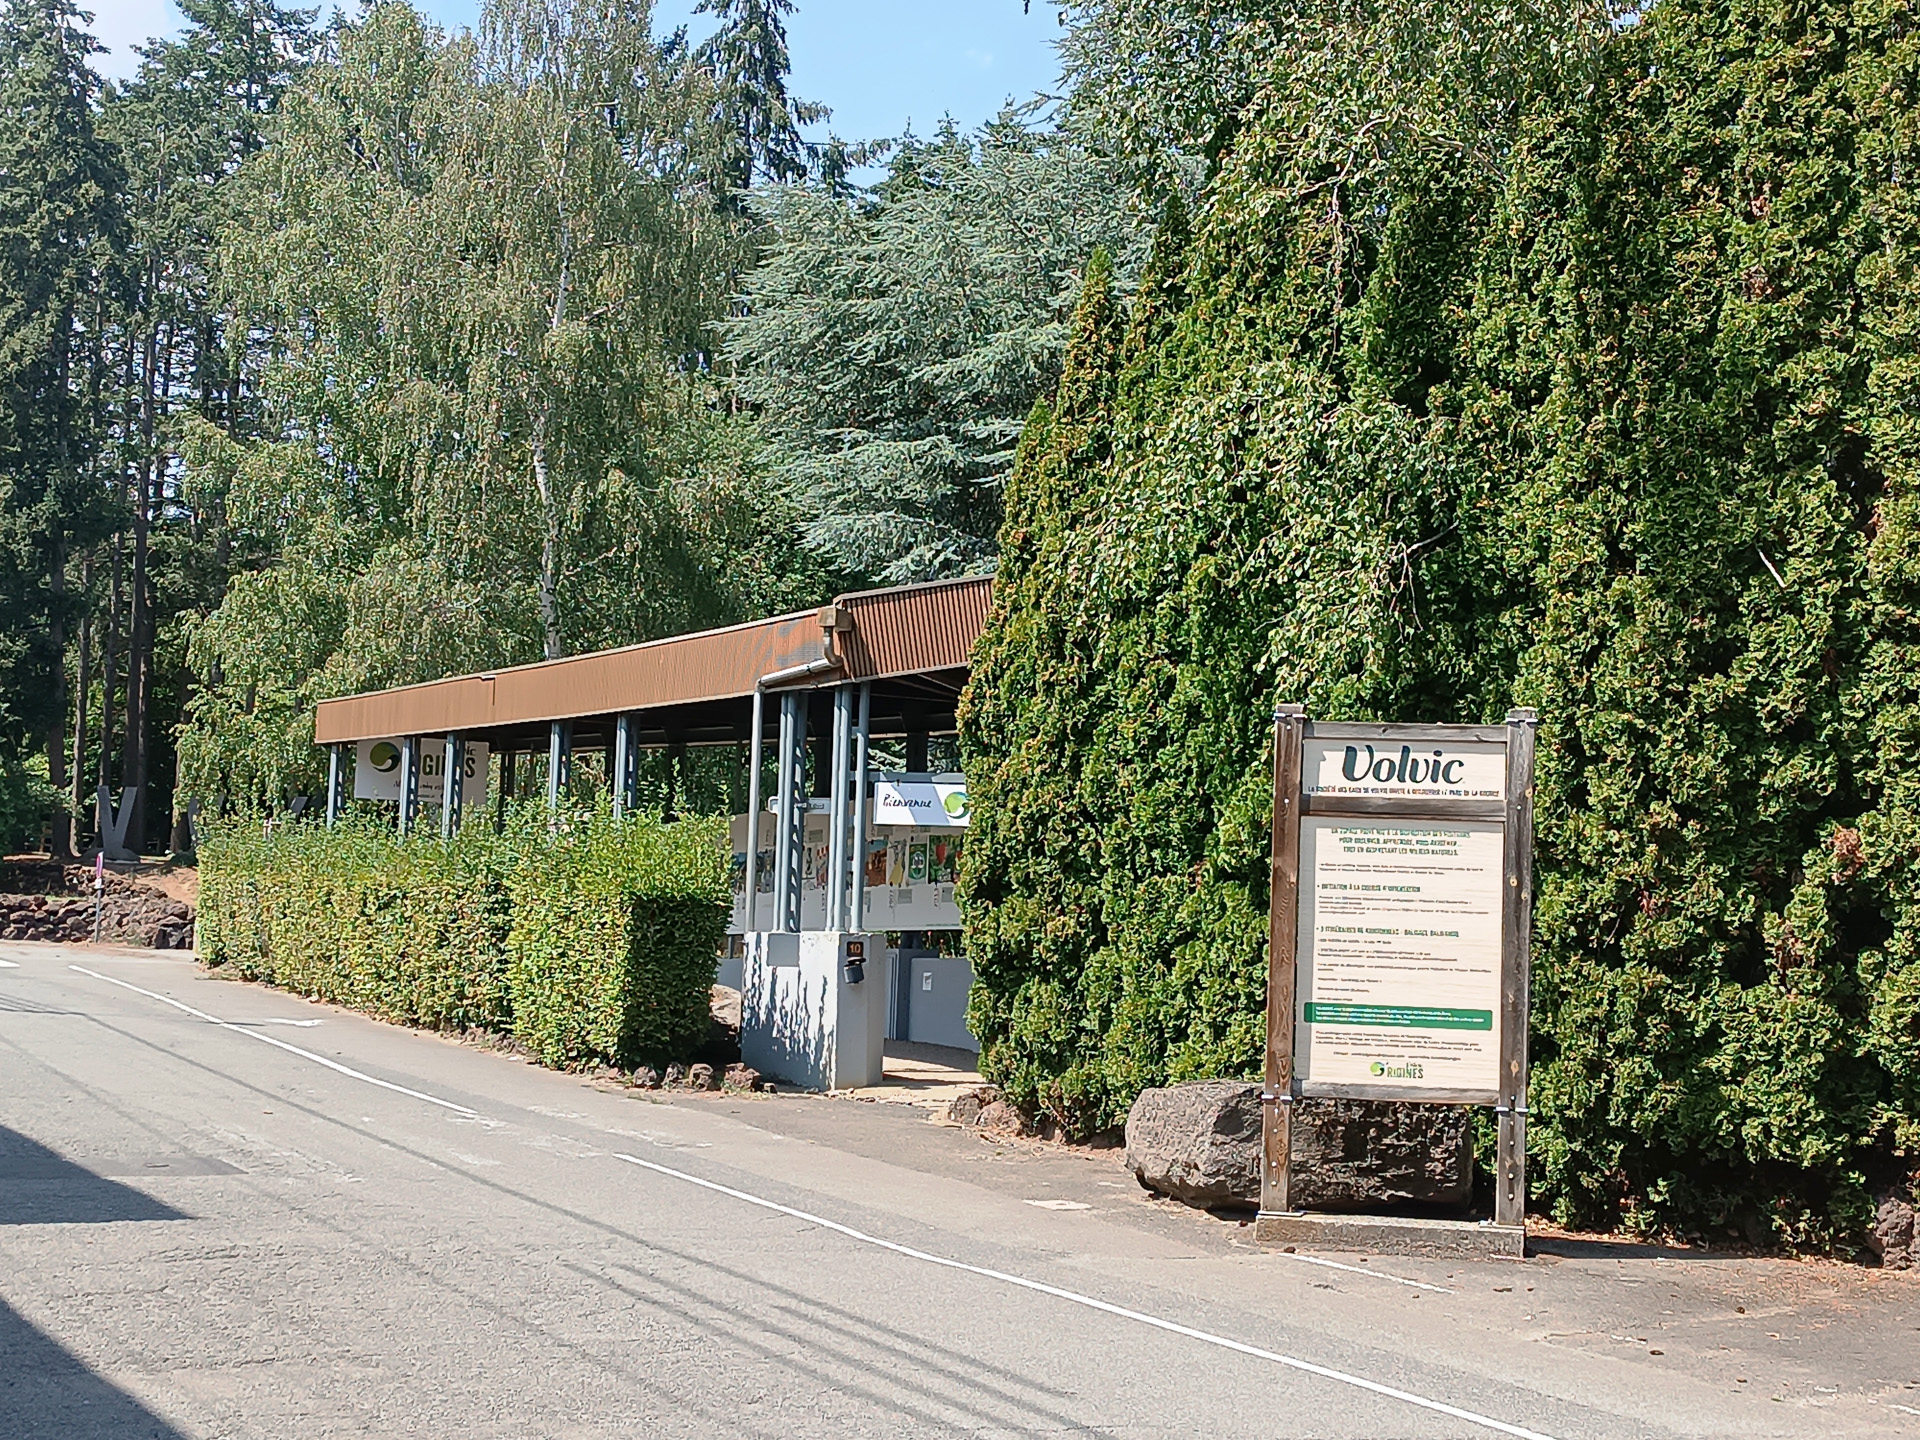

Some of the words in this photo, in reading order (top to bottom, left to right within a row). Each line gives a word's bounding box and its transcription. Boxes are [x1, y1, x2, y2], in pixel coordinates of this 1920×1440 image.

[1342, 745, 1464, 784] Volvic
[883, 793, 932, 808] Bienvenue
[850, 943, 861, 954] 10
